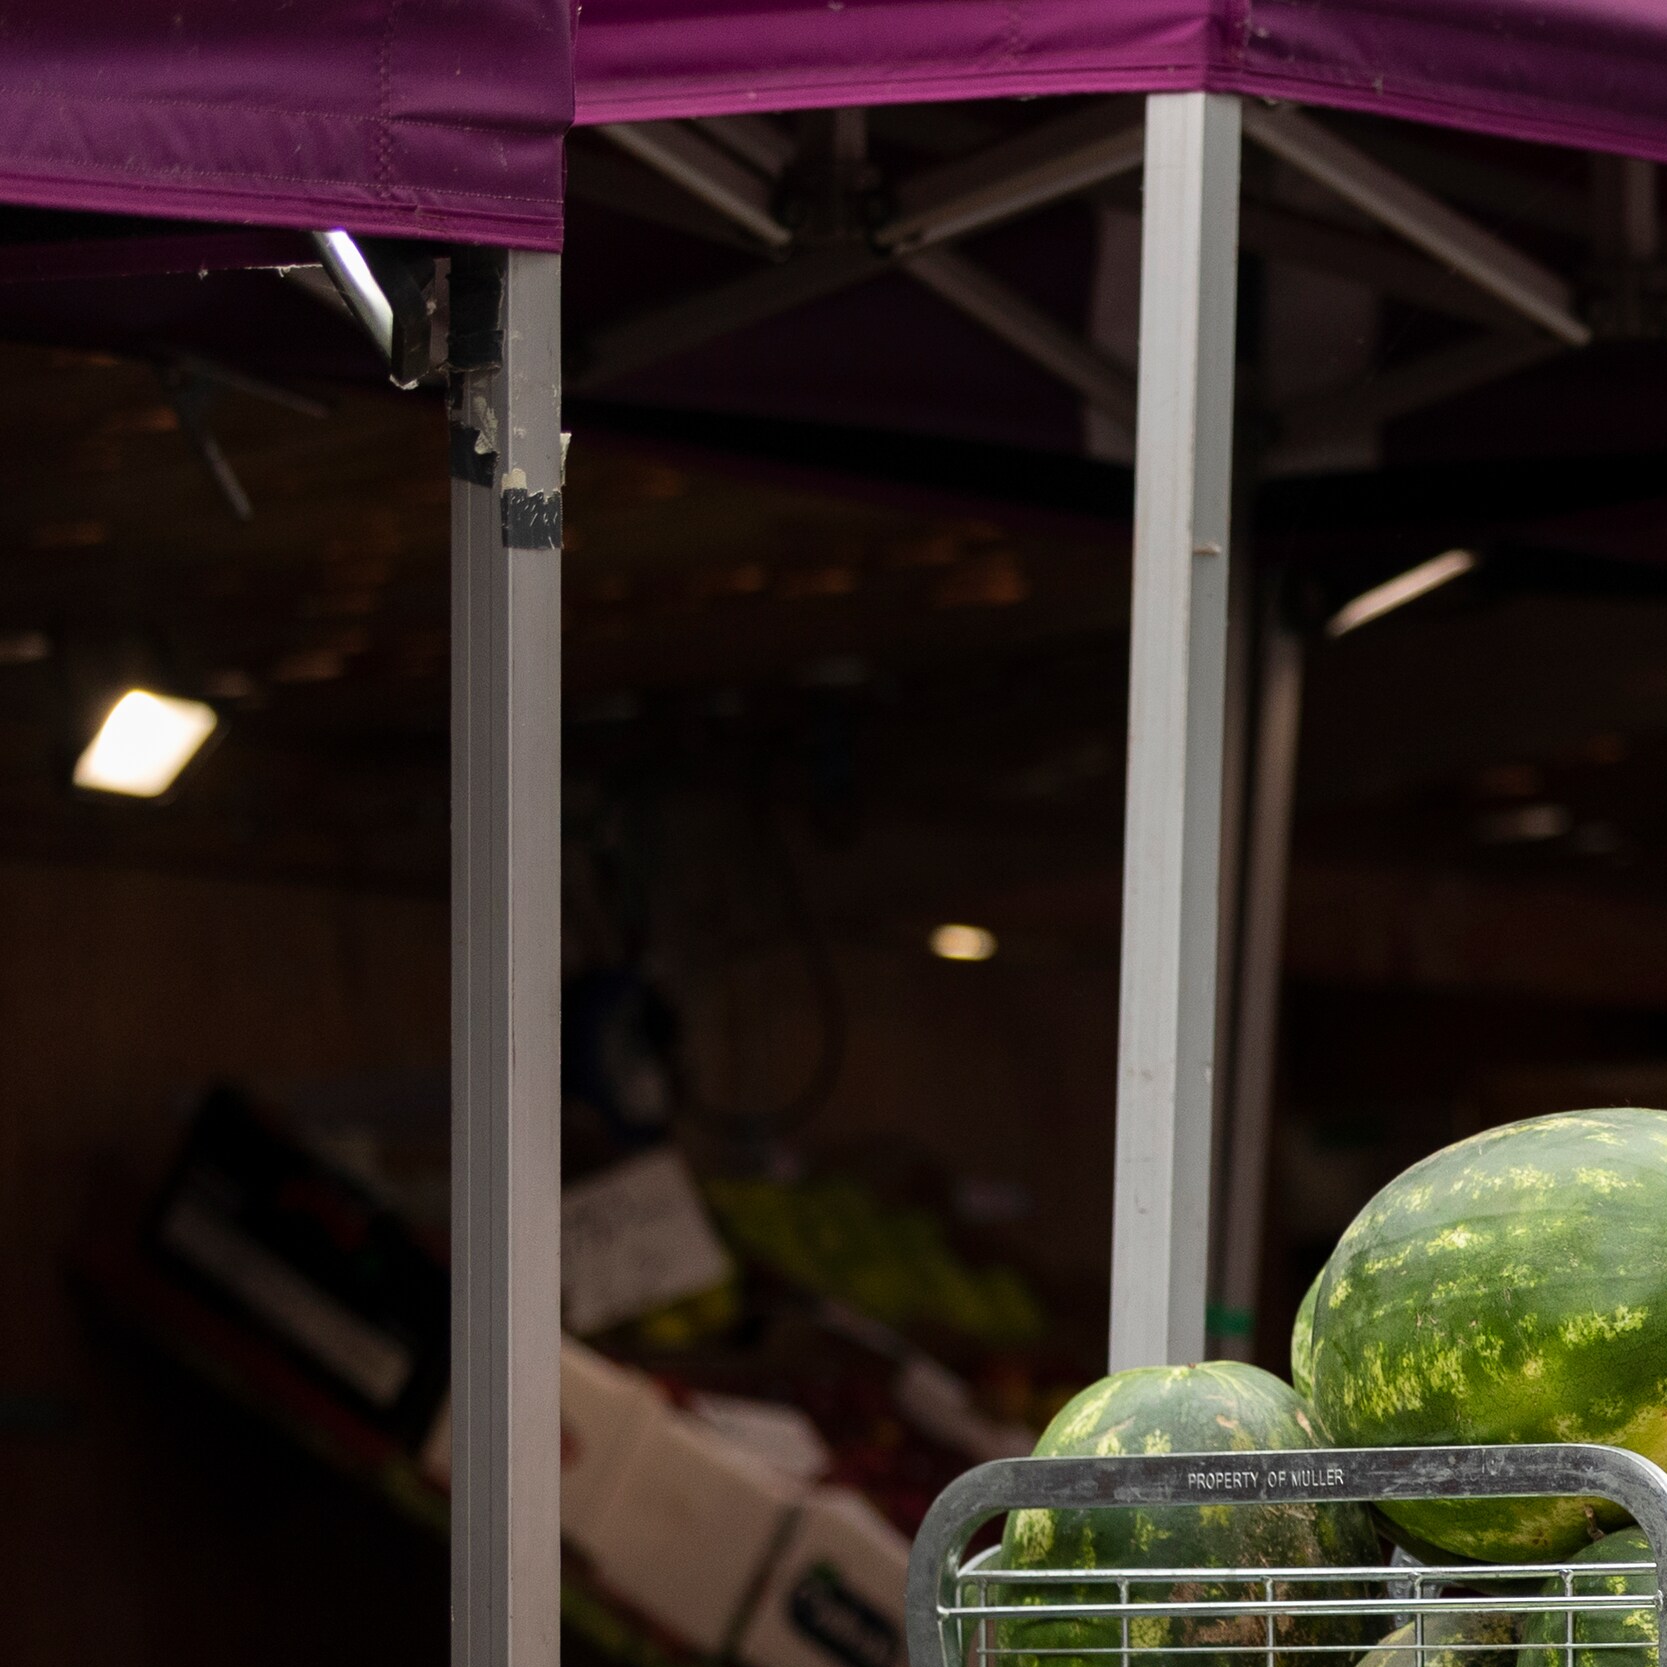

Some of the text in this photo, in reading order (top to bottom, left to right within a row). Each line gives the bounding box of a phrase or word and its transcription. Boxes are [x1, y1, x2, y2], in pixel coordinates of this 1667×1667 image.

[1187, 1468, 1345, 1490] PROPERTY OF MULLER
